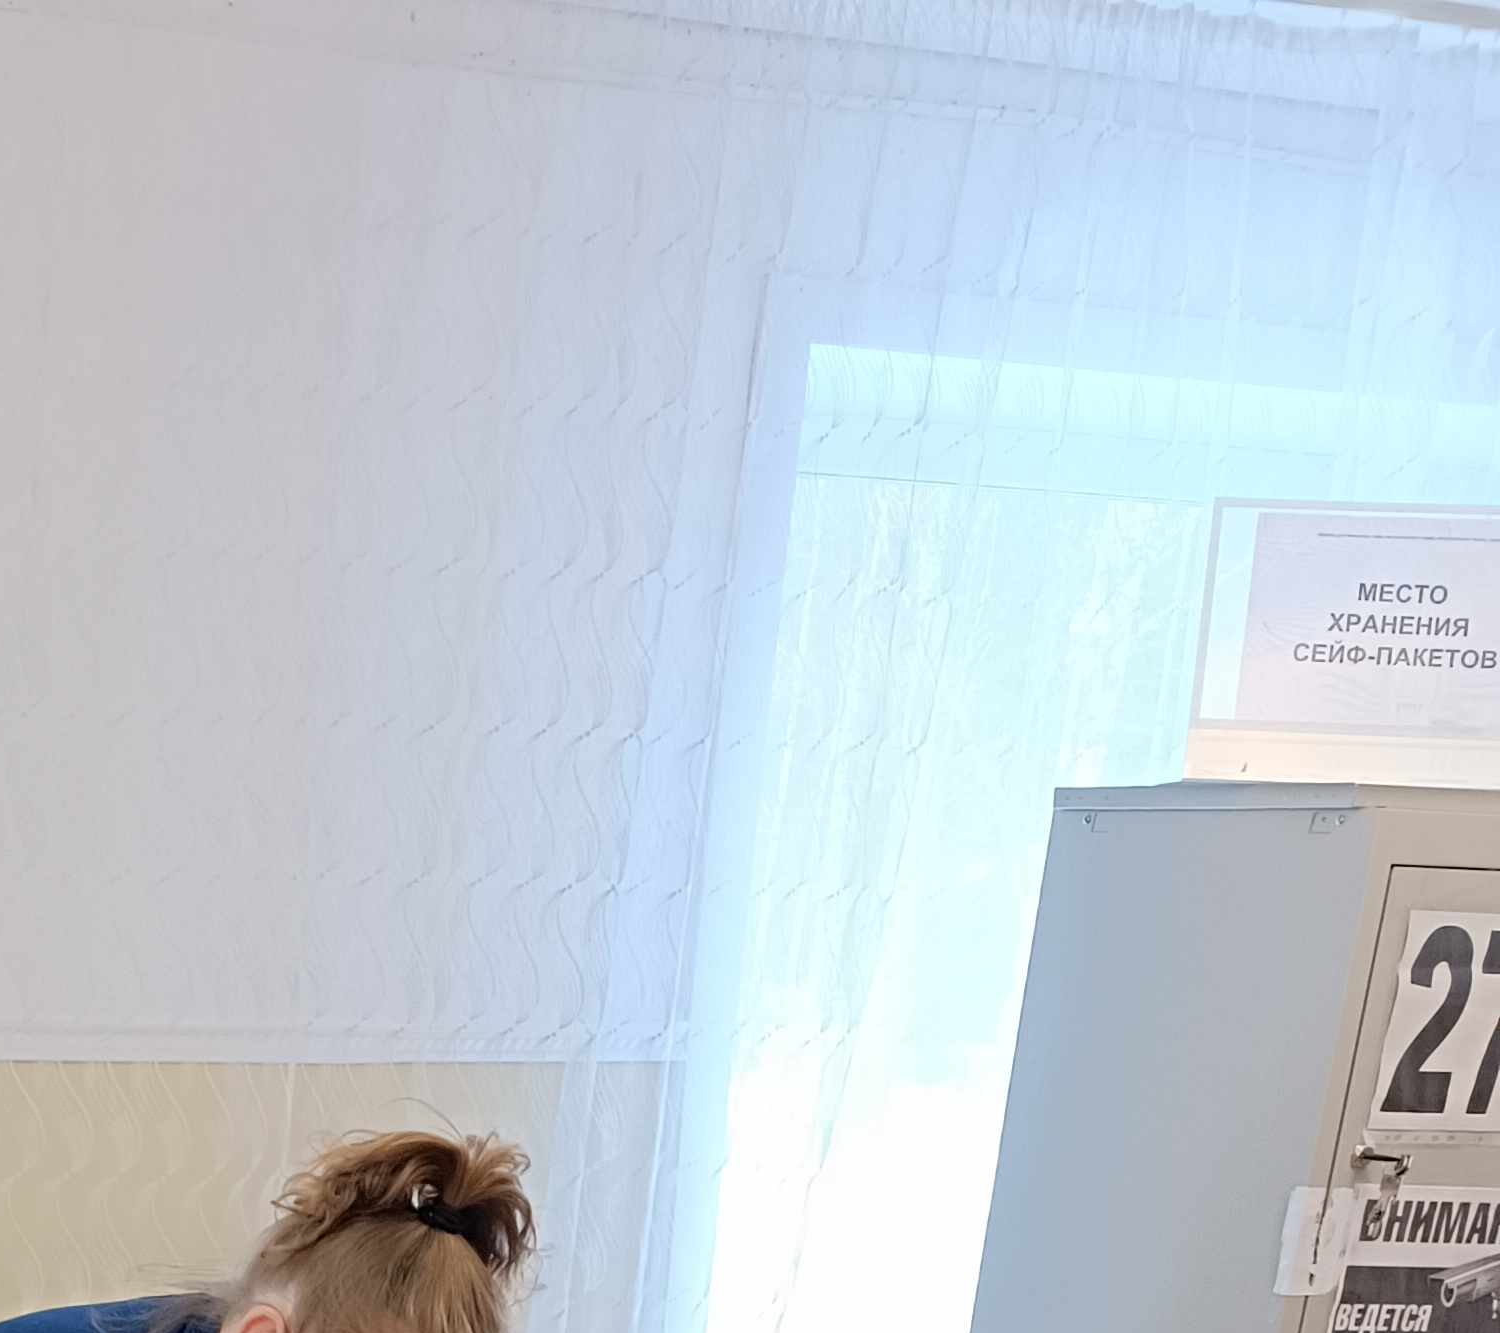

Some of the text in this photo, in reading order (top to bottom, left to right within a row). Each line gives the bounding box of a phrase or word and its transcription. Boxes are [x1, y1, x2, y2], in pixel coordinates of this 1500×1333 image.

[1357, 582, 1448, 605] МЕСТО
[1327, 612, 1470, 638] ХРАНЕНИЯ
[1293, 639, 1498, 670] СЕЙФ-ПАКЕТОВ
